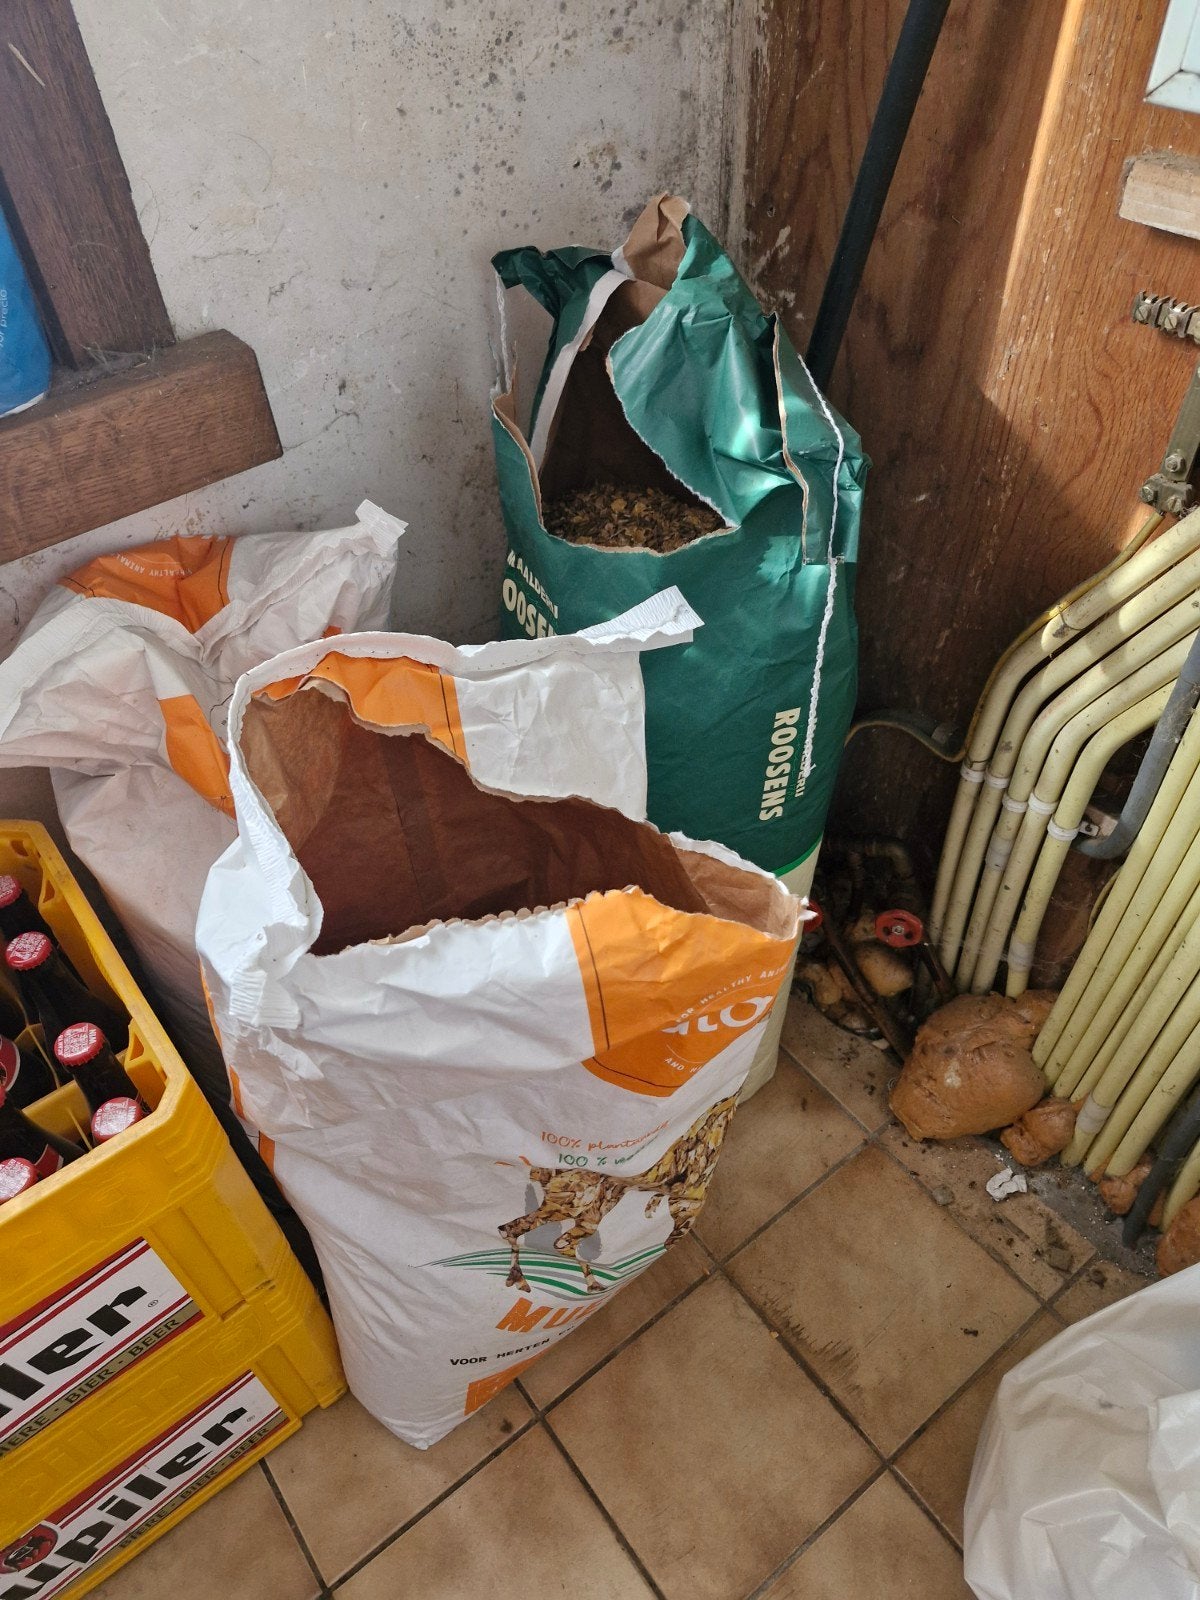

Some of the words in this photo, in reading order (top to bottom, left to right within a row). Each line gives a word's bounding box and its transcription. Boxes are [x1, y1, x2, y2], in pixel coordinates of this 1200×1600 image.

[0, 289, 8, 328] precio
[104, 552, 146, 575] ANIMAL
[759, 706, 802, 821] ROOSENS
[664, 1057, 686, 1071] AND
[541, 1131, 582, 1149] 100%
[558, 1153, 588, 1167] 100
[0, 1286, 148, 1419] ler
[450, 1356, 488, 1366] VOOR
[496, 1338, 550, 1359] HERTEN
[0, 1415, 50, 1457] IERE
[64, 1368, 117, 1405] BIER
[128, 1318, 182, 1358] BEER
[178, 1469, 220, 1500] BIER
[229, 1427, 270, 1461] BEER
